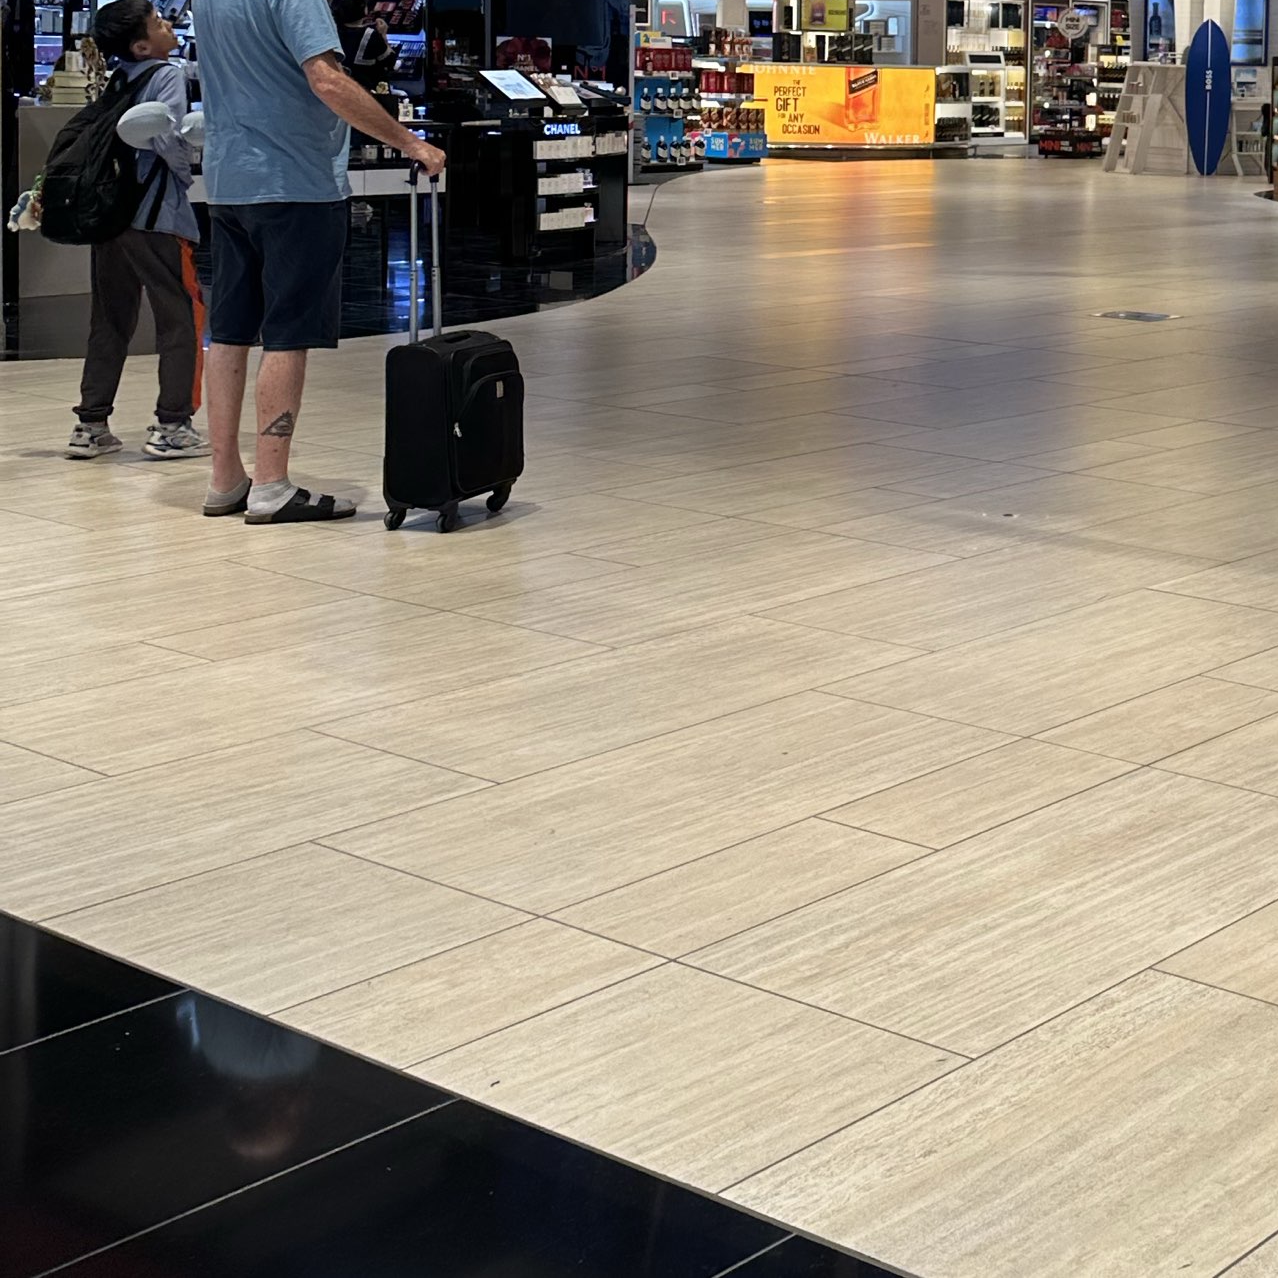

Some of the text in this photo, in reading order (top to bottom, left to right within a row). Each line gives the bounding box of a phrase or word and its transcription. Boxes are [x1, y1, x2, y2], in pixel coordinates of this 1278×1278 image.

[1205, 69, 1213, 92] BOSS
[774, 86, 807, 98] PERFECT
[776, 98, 799, 112] GIFT
[788, 113, 805, 123] ANY
[543, 123, 582, 136] CHANEL
[782, 125, 820, 135] OCCASION
[864, 132, 921, 145] WALKER
